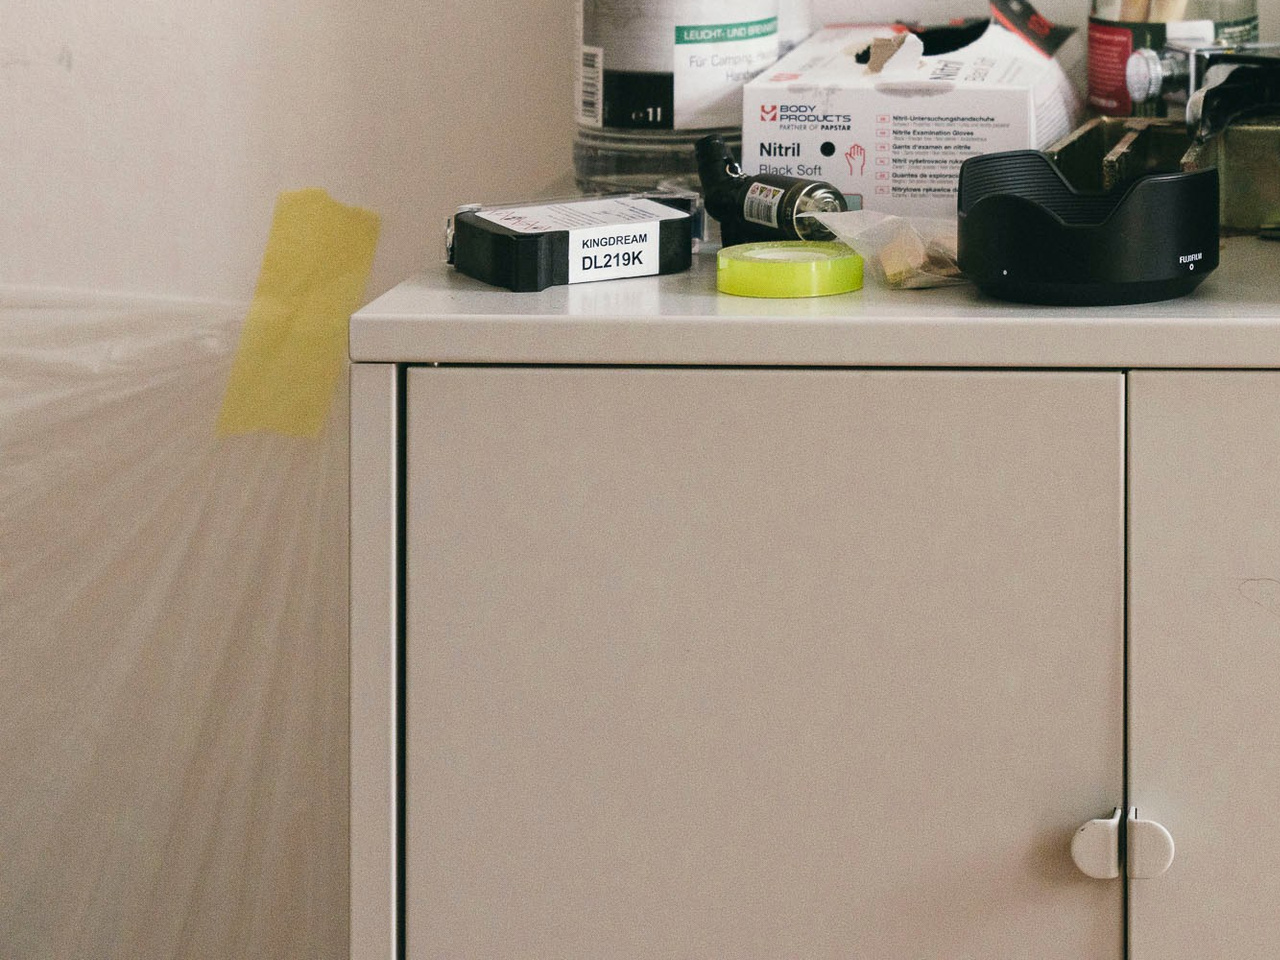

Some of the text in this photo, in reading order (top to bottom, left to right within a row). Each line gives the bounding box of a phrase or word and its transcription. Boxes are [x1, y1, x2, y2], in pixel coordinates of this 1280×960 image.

[779, 115, 852, 123] PRODUCTS
[760, 142, 801, 157] Nitril
[759, 164, 822, 176] Black Soft
[582, 233, 648, 249] KINGDREAM
[582, 250, 643, 271] DL219K
[1179, 252, 1203, 264] FUJIFILM
